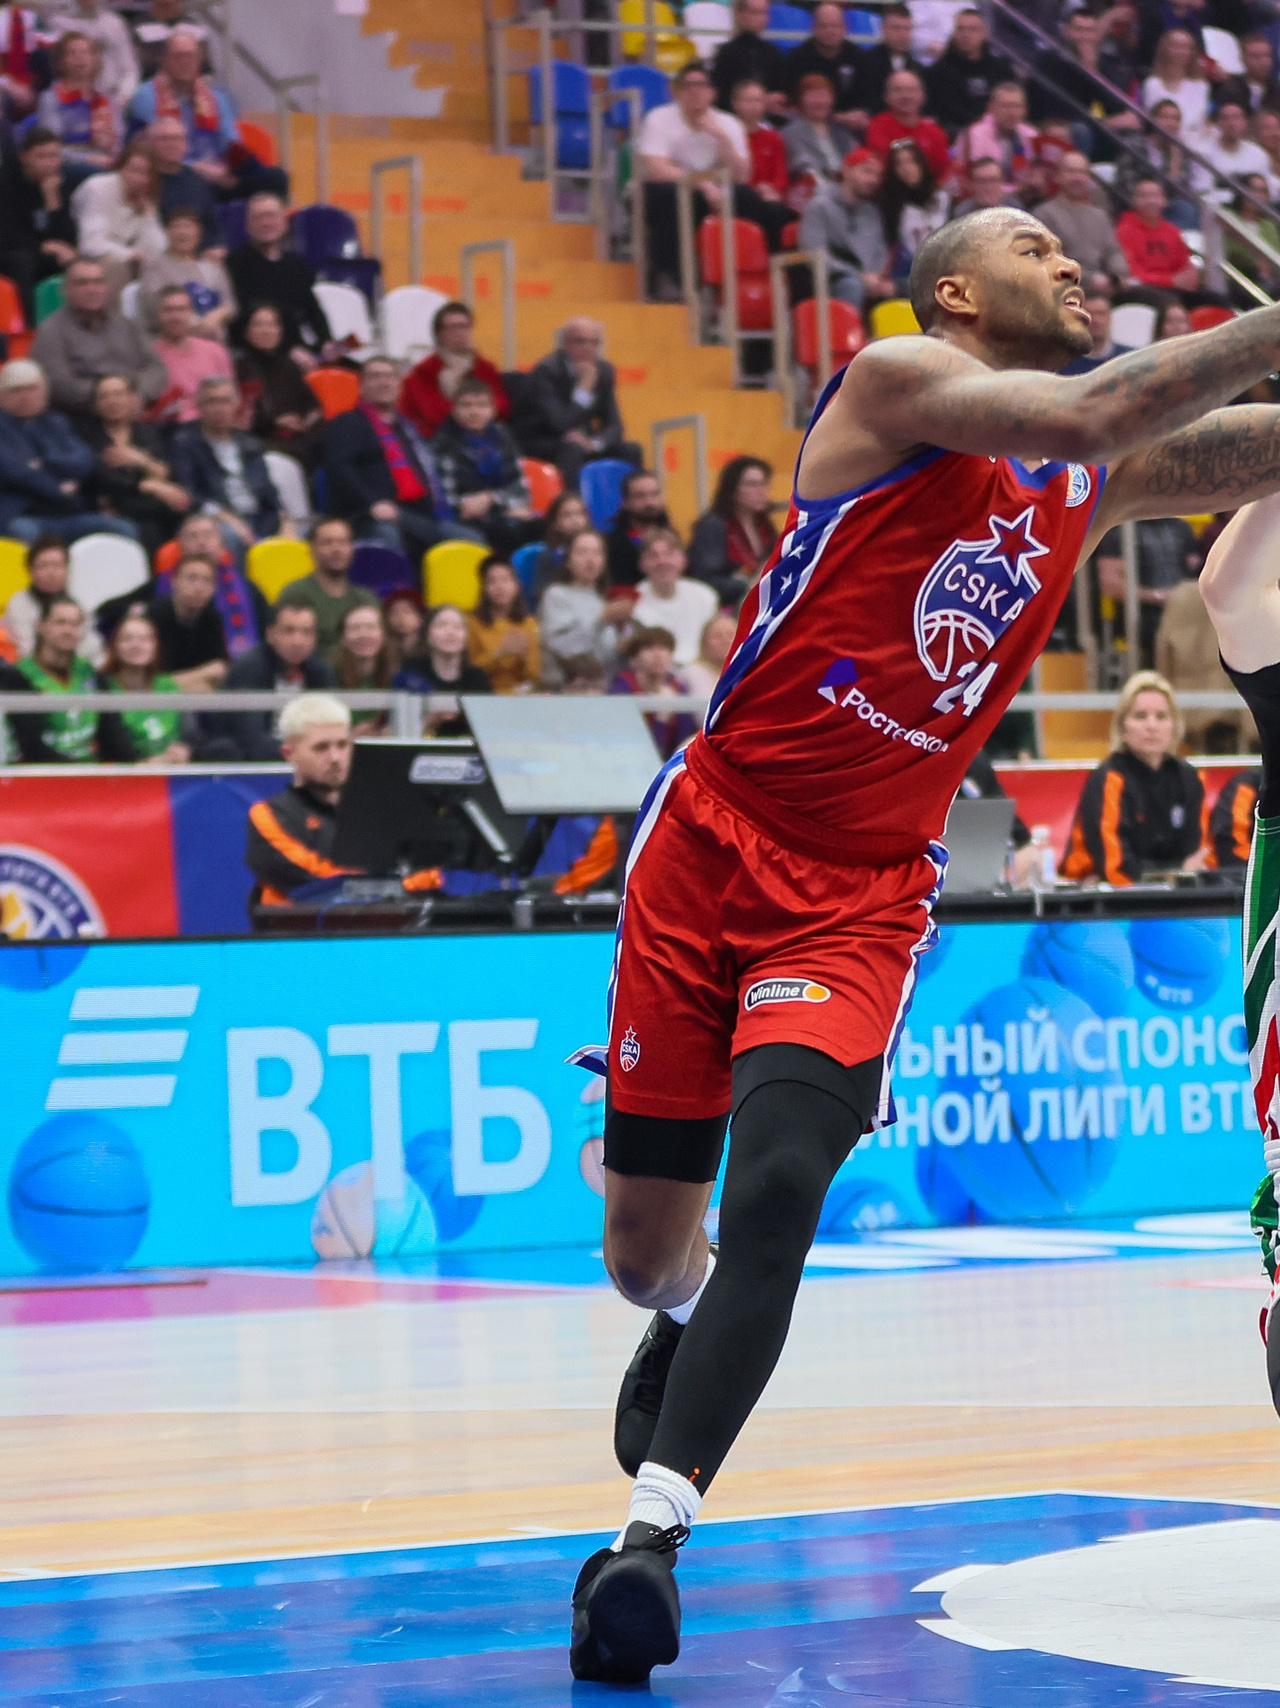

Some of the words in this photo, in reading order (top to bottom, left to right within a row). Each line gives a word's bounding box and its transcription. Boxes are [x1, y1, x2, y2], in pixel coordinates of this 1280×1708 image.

[943, 562, 1026, 623] CSKA
[932, 660, 999, 717] 24
[750, 983, 801, 1004] Winline
[890, 1006, 1059, 1079] ЬНЫЙ
[226, 1017, 552, 1207] ВТБ
[1022, 1085, 1167, 1143] ЛИГИ
